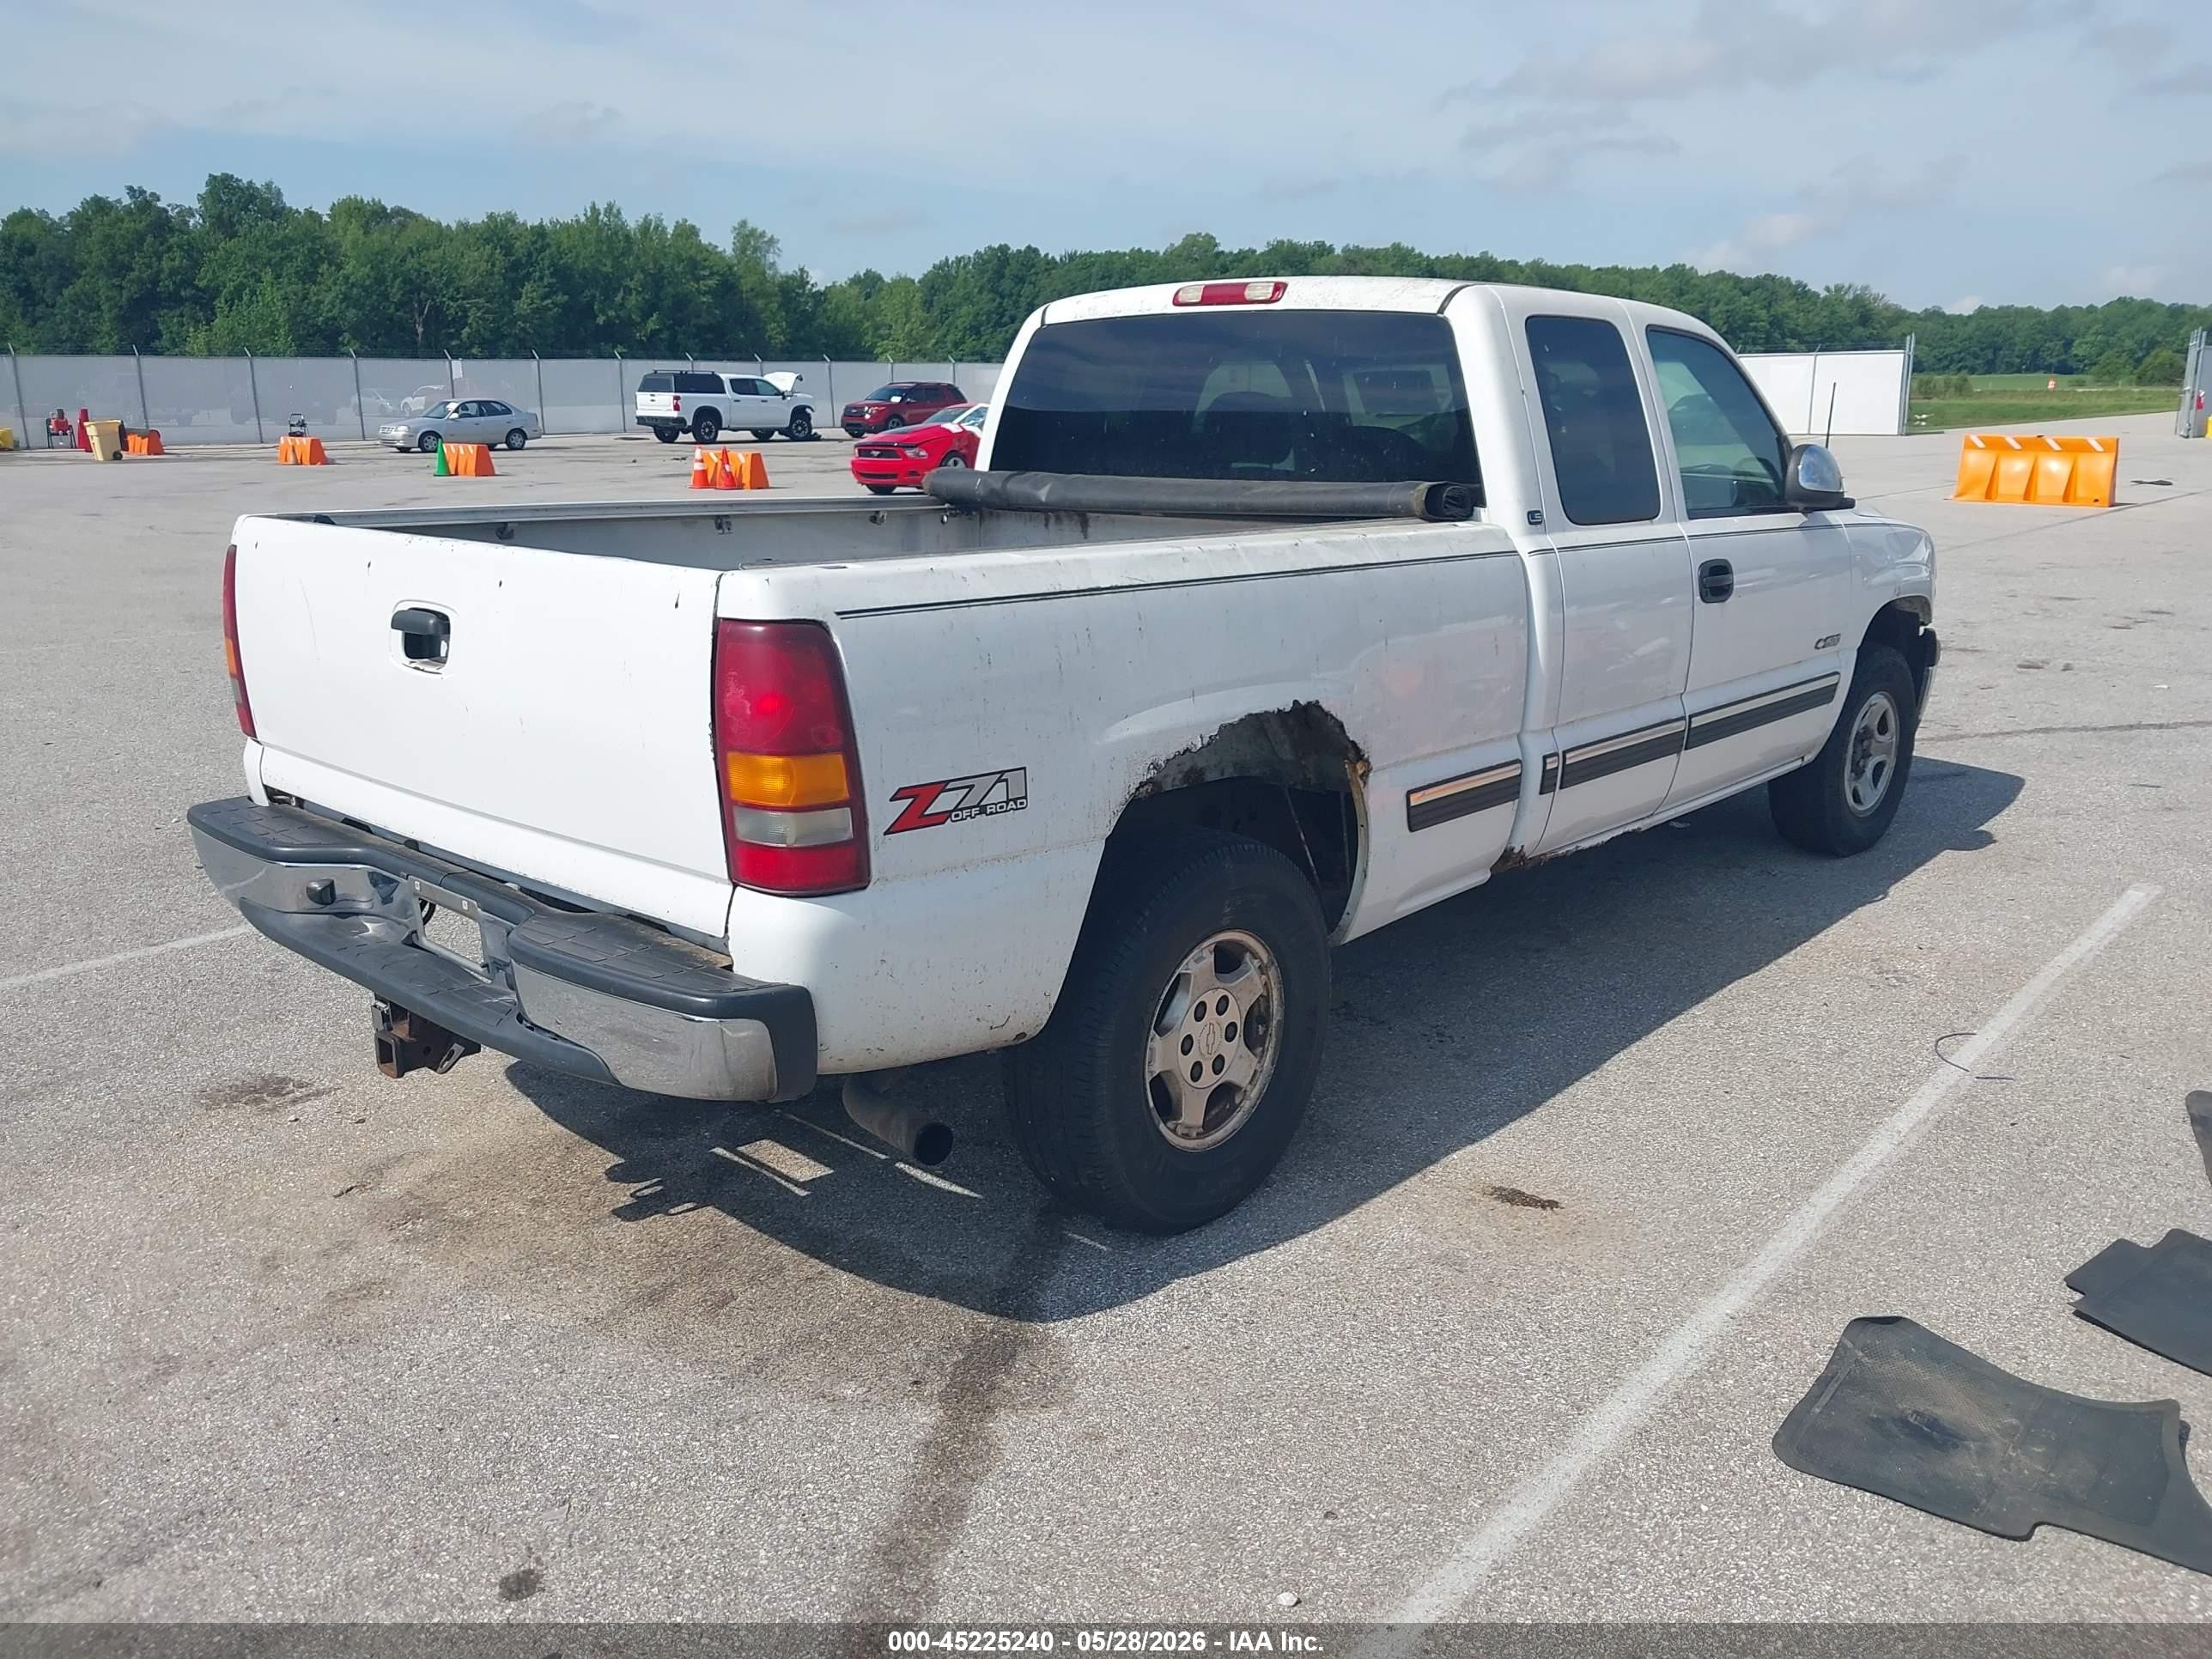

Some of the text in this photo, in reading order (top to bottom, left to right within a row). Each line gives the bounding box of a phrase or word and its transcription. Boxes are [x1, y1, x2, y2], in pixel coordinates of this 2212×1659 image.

[884, 767, 1027, 836] Z71
[951, 798, 1028, 822] OFF ROAD
